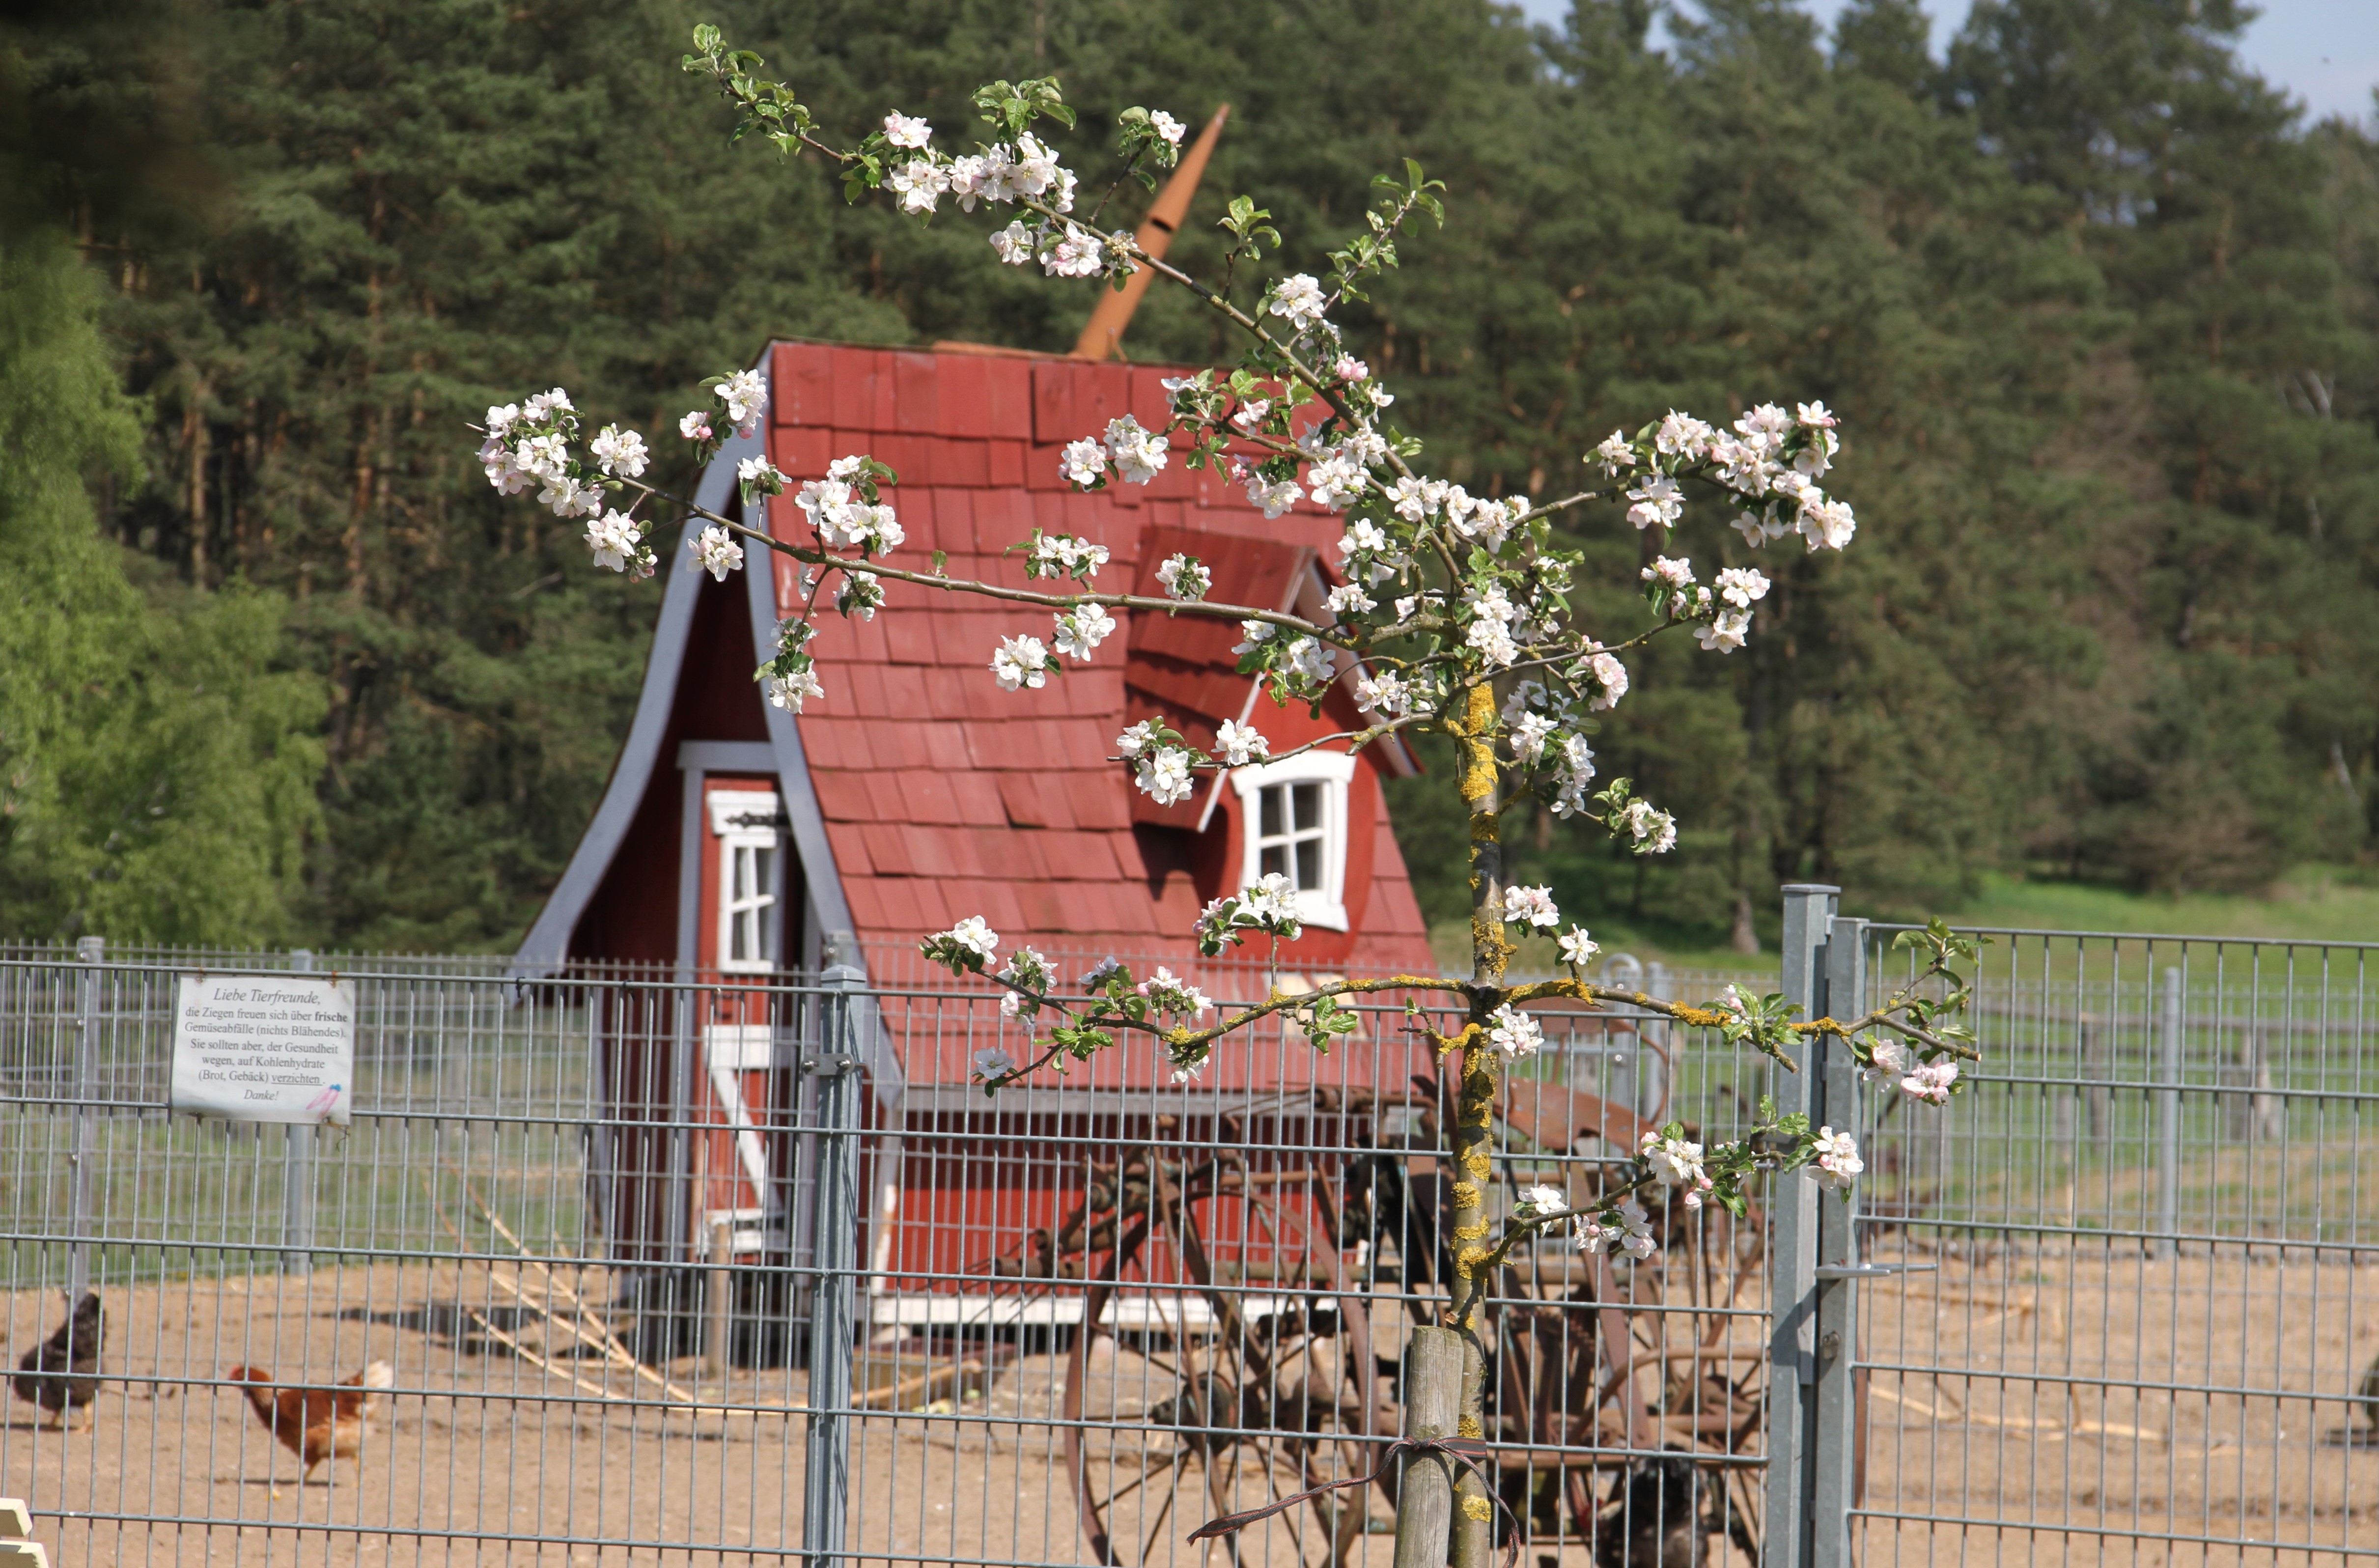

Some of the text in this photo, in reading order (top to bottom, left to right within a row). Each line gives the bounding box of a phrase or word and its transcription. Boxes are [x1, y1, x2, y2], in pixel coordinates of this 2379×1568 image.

[213, 988, 320, 1005] Liebe Tierfreunde,
[185, 1007, 347, 1022] die Ziegen freuen sich über frische
[185, 1022, 253, 1034] Gemüseabfälle
[256, 1024, 288, 1036] (nichts
[190, 1038, 338, 1054] Sie sollten aber, der Gesundheit
[202, 1056, 325, 1070] wegen, auf Kohlenhydrate
[198, 1069, 226, 1081] (Brot,
[229, 1070, 268, 1084] Gebäck)
[244, 1089, 279, 1101] Danke!
